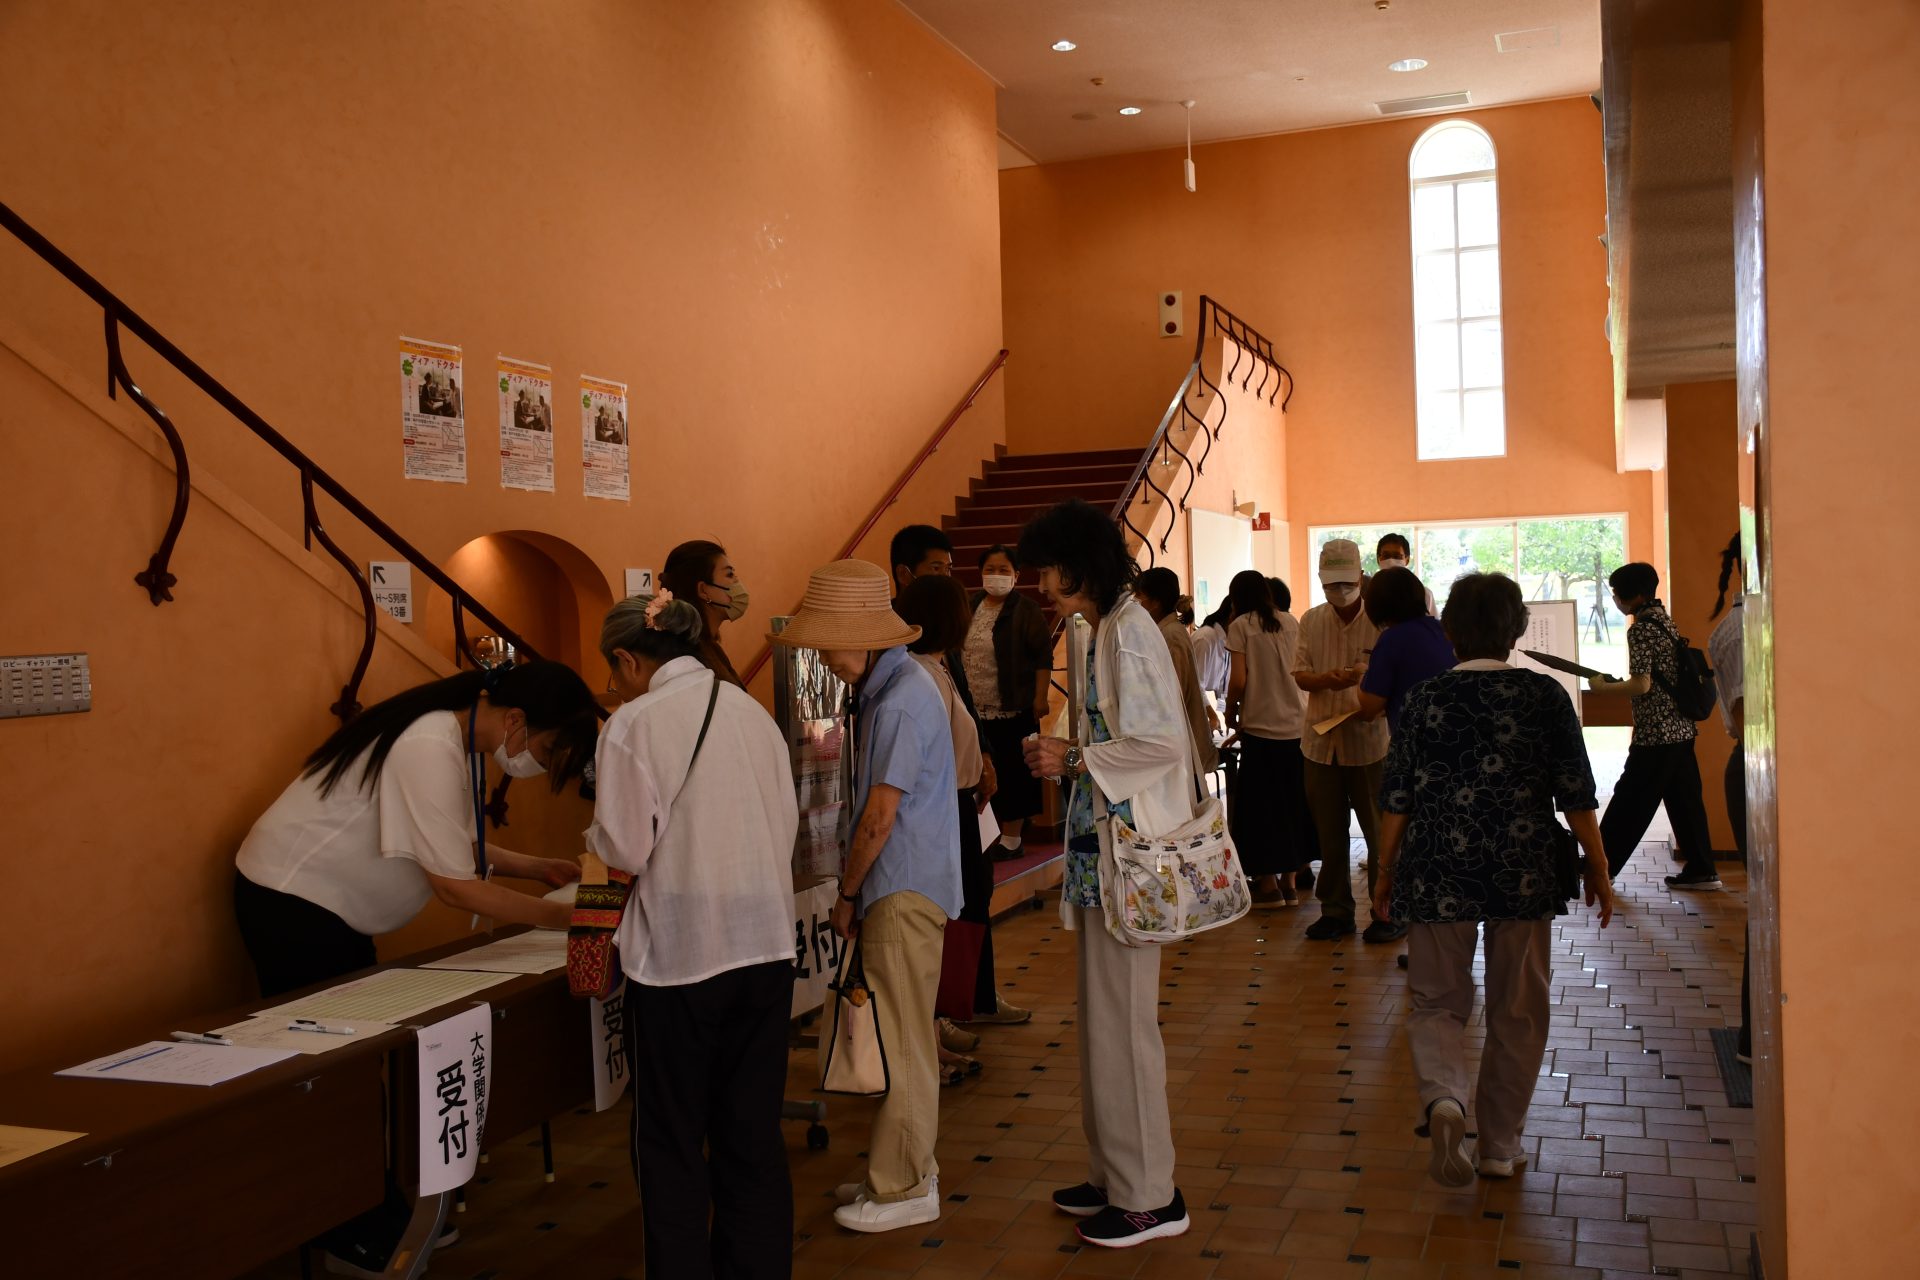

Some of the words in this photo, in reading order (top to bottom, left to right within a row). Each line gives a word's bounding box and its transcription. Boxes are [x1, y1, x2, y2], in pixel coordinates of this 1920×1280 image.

[589, 390, 624, 404] ディア・ドクタ
[603, 996, 625, 1084] 受付
[436, 1059, 470, 1165] 受付
